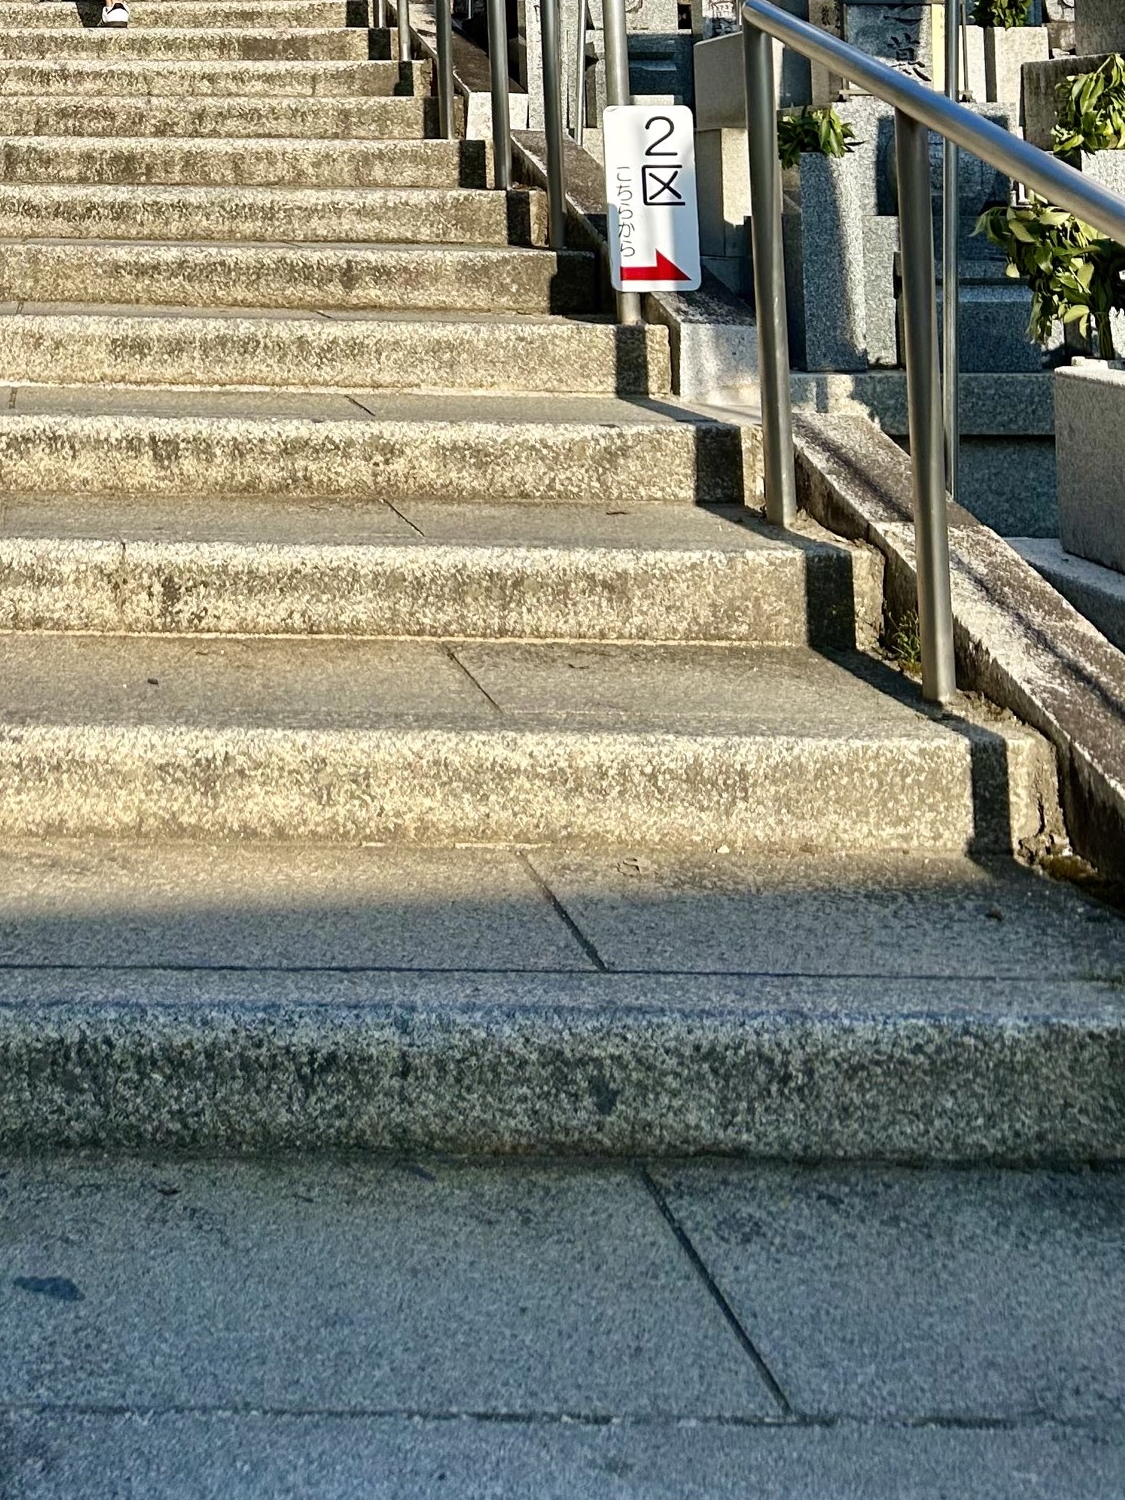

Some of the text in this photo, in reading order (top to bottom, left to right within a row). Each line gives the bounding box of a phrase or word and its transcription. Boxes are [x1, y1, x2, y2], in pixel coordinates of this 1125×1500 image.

[641, 115, 686, 206] 2区
[616, 165, 636, 258] こちらから
